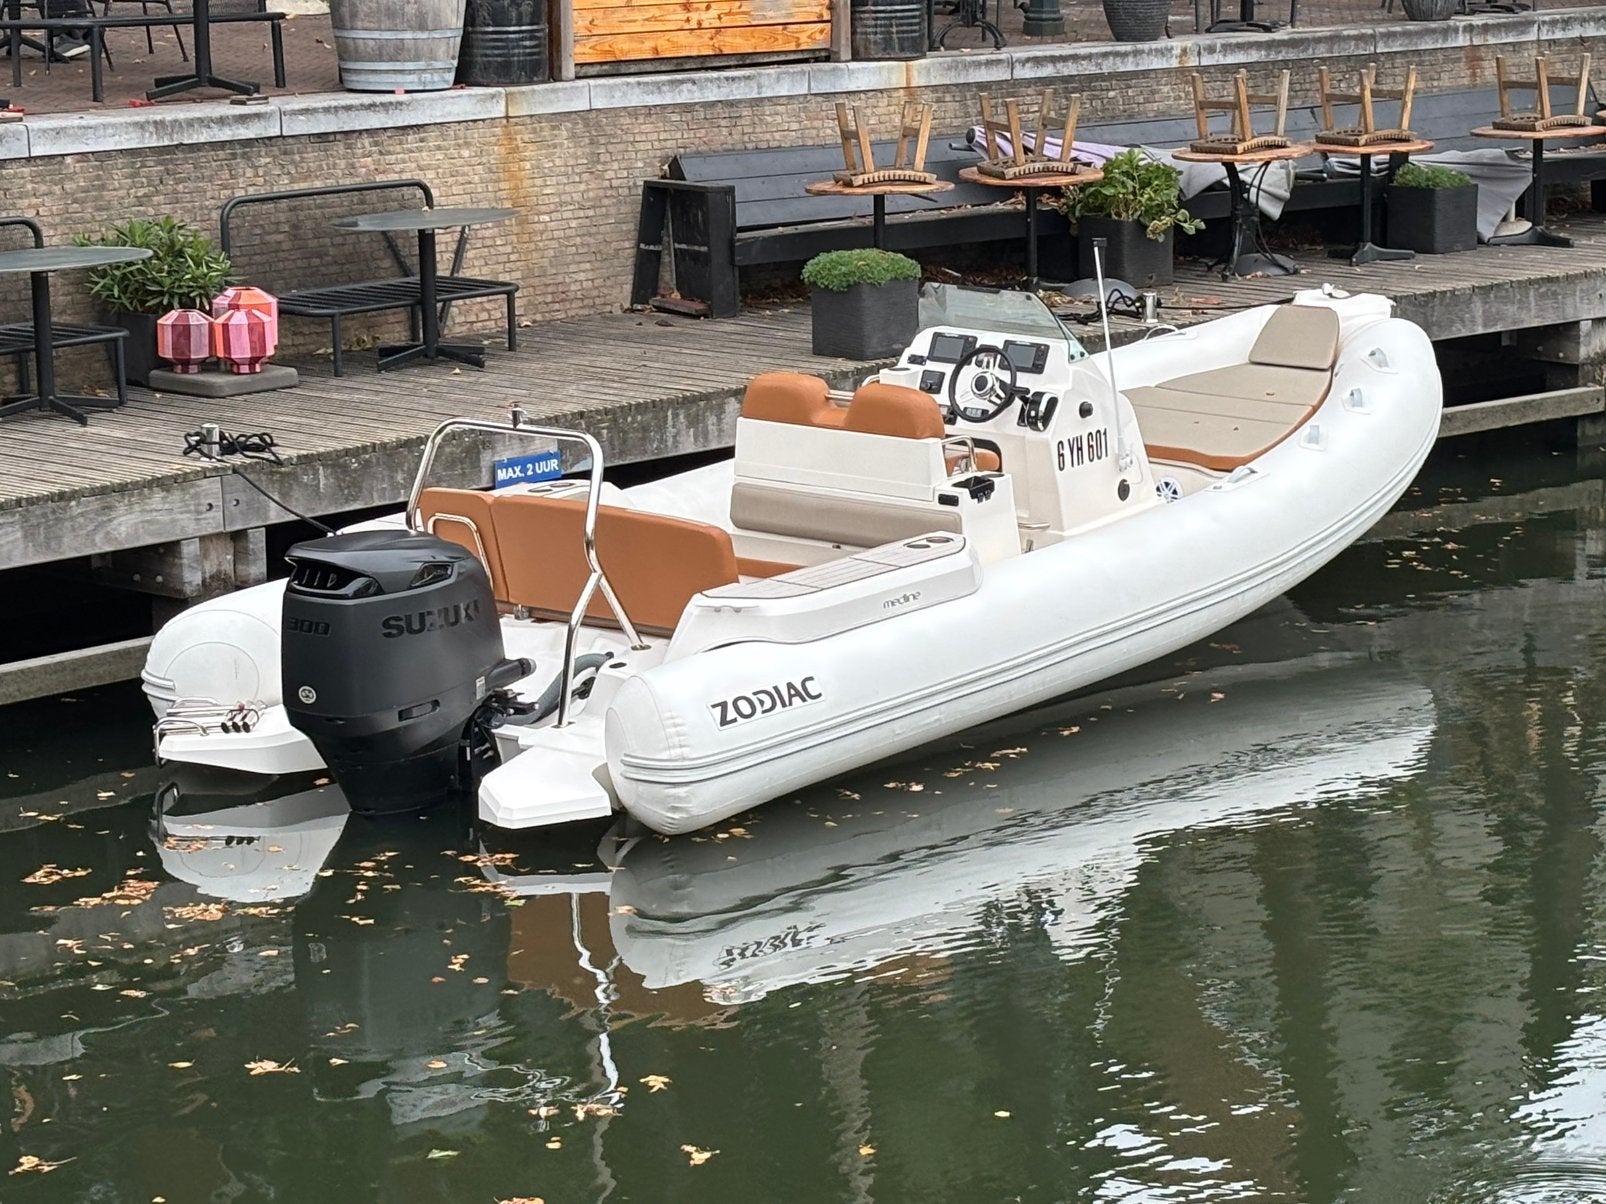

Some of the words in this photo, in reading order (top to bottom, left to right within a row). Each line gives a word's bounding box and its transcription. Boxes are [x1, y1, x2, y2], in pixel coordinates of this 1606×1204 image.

[1057, 440, 1065, 471] 6
[1067, 434, 1084, 468] YH
[1087, 427, 1109, 462] 601
[497, 465, 525, 481] MAX.
[526, 463, 534, 476] 2
[535, 458, 559, 474] UUR
[286, 616, 331, 637] 300
[381, 600, 480, 639] SUZUKI
[710, 676, 823, 727] ZODIAC
